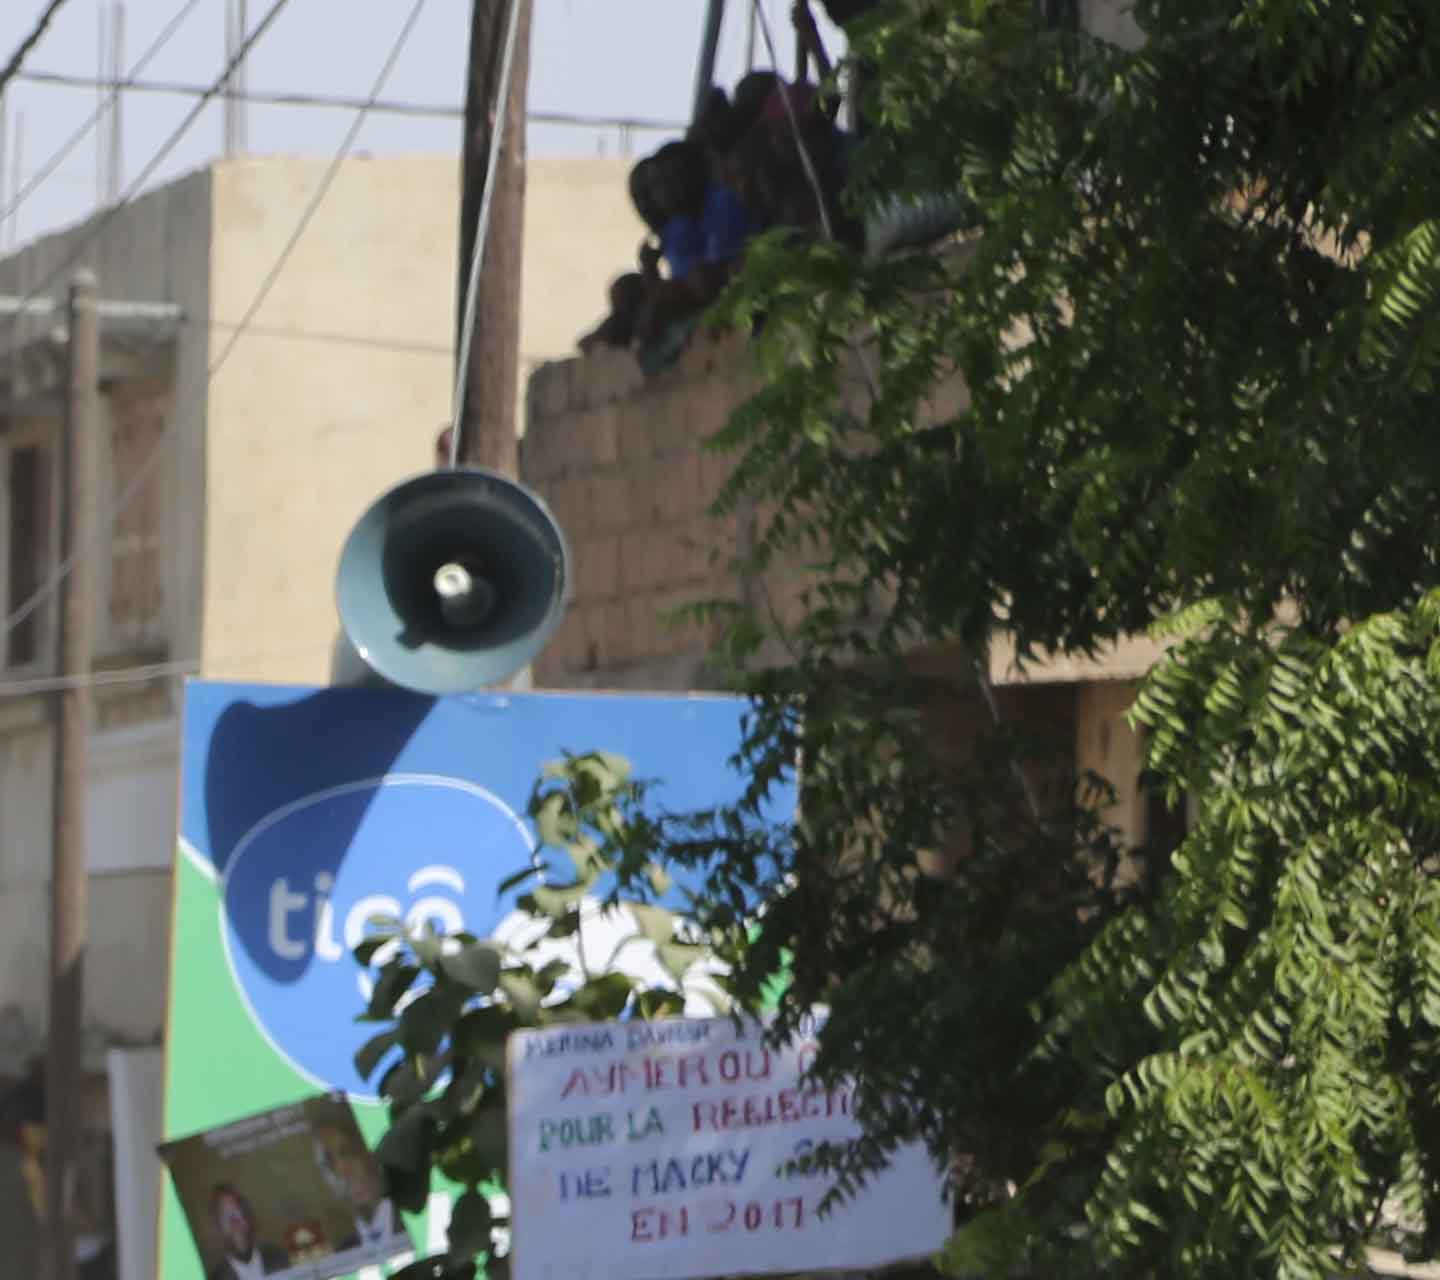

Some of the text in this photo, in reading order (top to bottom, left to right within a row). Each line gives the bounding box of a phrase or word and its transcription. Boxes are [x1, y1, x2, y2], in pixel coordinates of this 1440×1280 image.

[268, 866, 466, 975] tigo
[539, 1086, 852, 1154] POUR LA REELECTI
[632, 1146, 752, 1198] MACKY
[630, 1204, 689, 1243] EN
